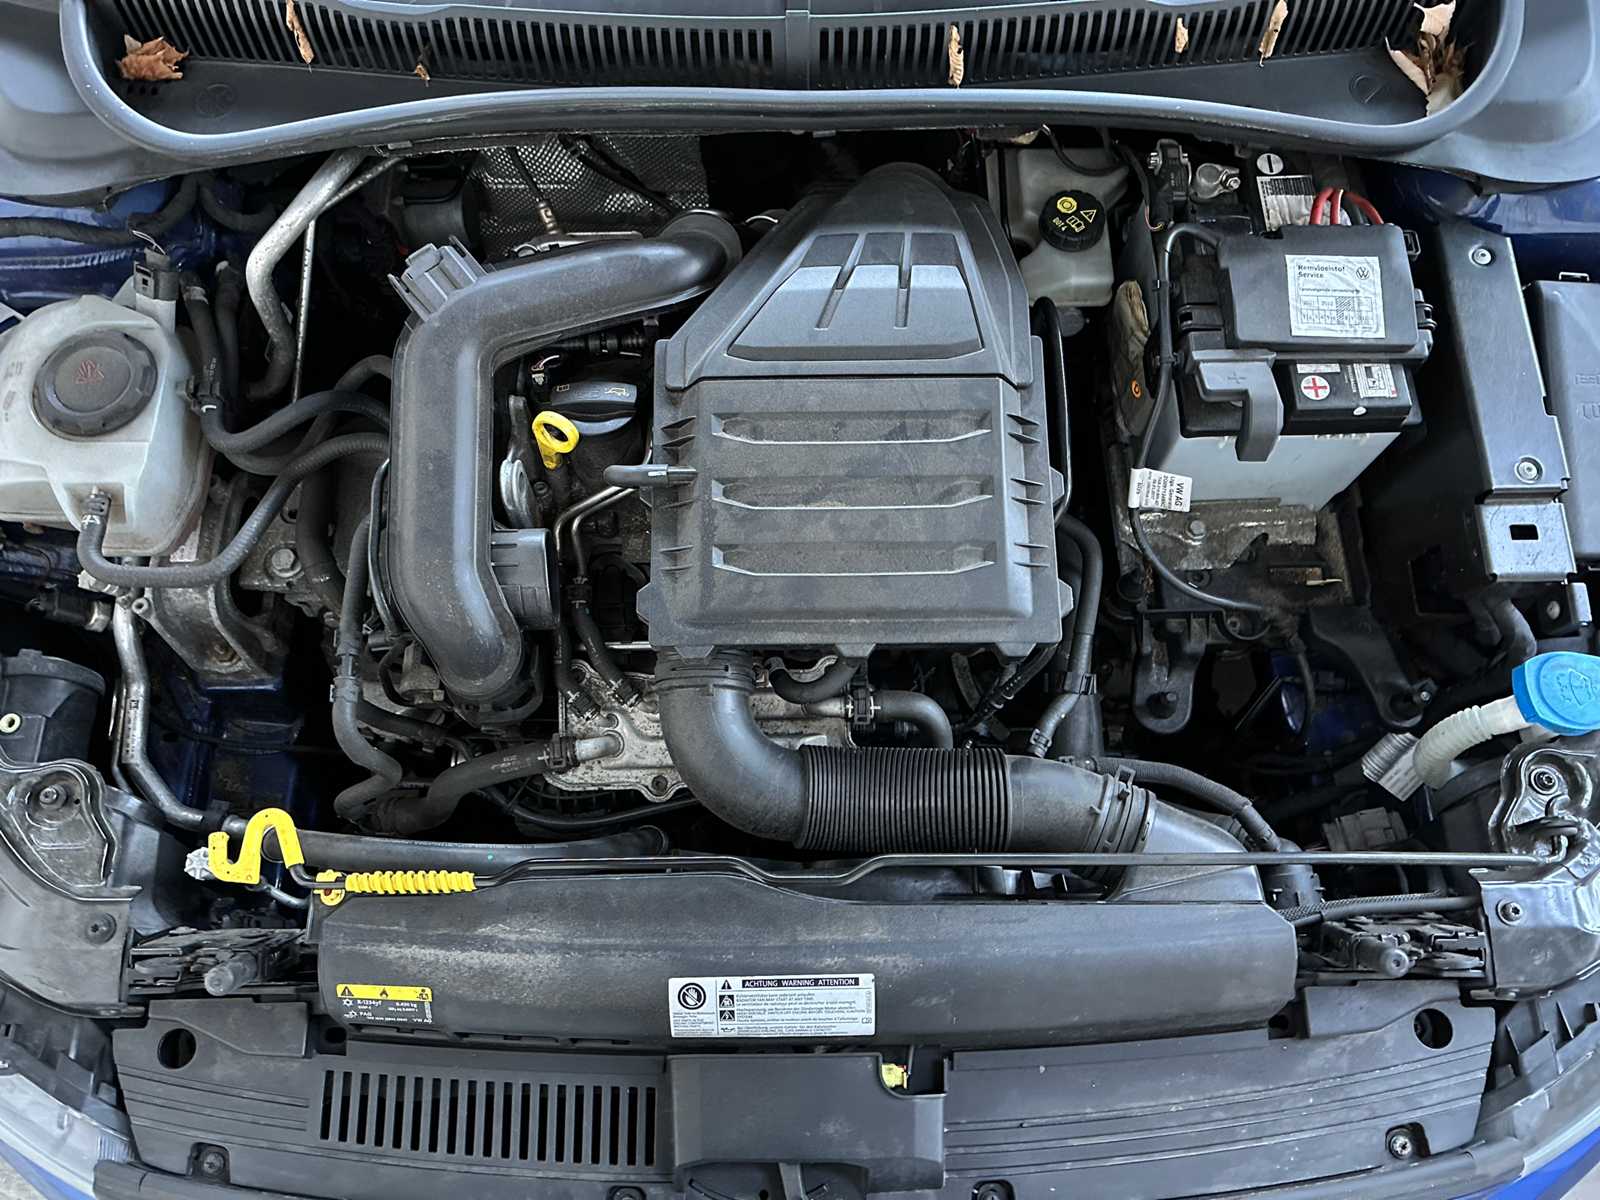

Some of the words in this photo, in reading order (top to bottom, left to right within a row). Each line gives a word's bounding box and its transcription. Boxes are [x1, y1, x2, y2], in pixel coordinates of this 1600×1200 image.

[1297, 271, 1324, 279] Service
[1175, 482, 1185, 496] VW
[1174, 495, 1184, 507] AG
